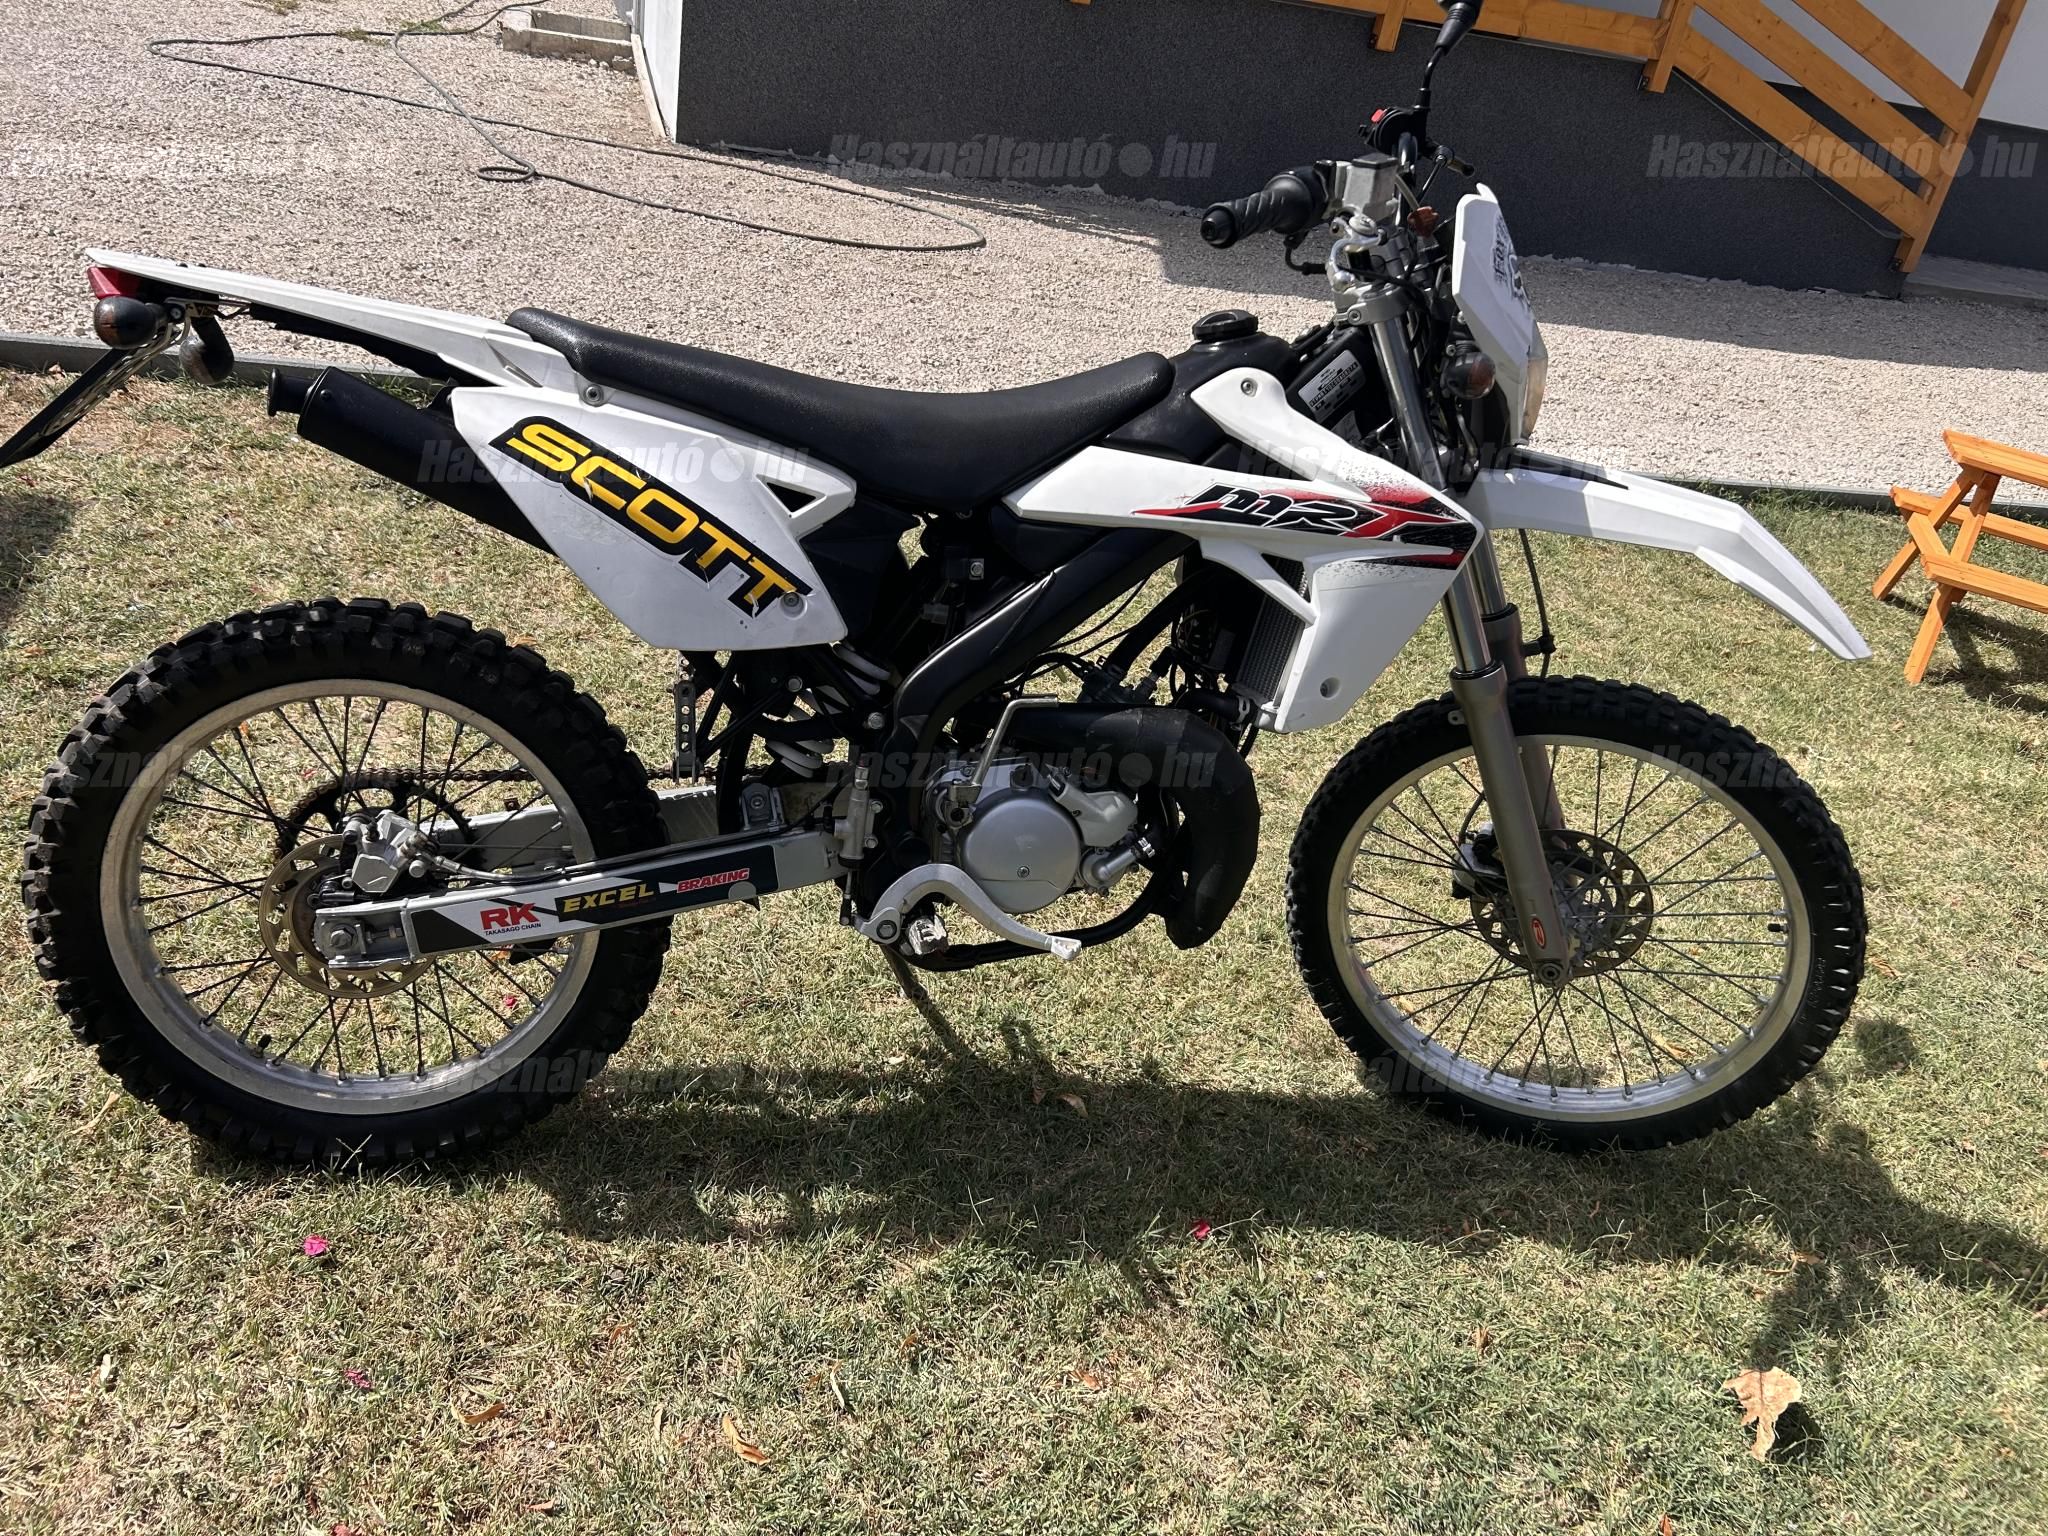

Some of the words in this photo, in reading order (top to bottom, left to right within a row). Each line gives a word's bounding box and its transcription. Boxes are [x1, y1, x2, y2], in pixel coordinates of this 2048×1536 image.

[505, 423, 798, 607] SCOTT
[676, 867, 751, 893] BRAKING
[562, 883, 656, 913] EXCEL
[479, 902, 541, 930] RK
[484, 924, 521, 936] TAKASAGO
[521, 922, 542, 932] CHAIN
